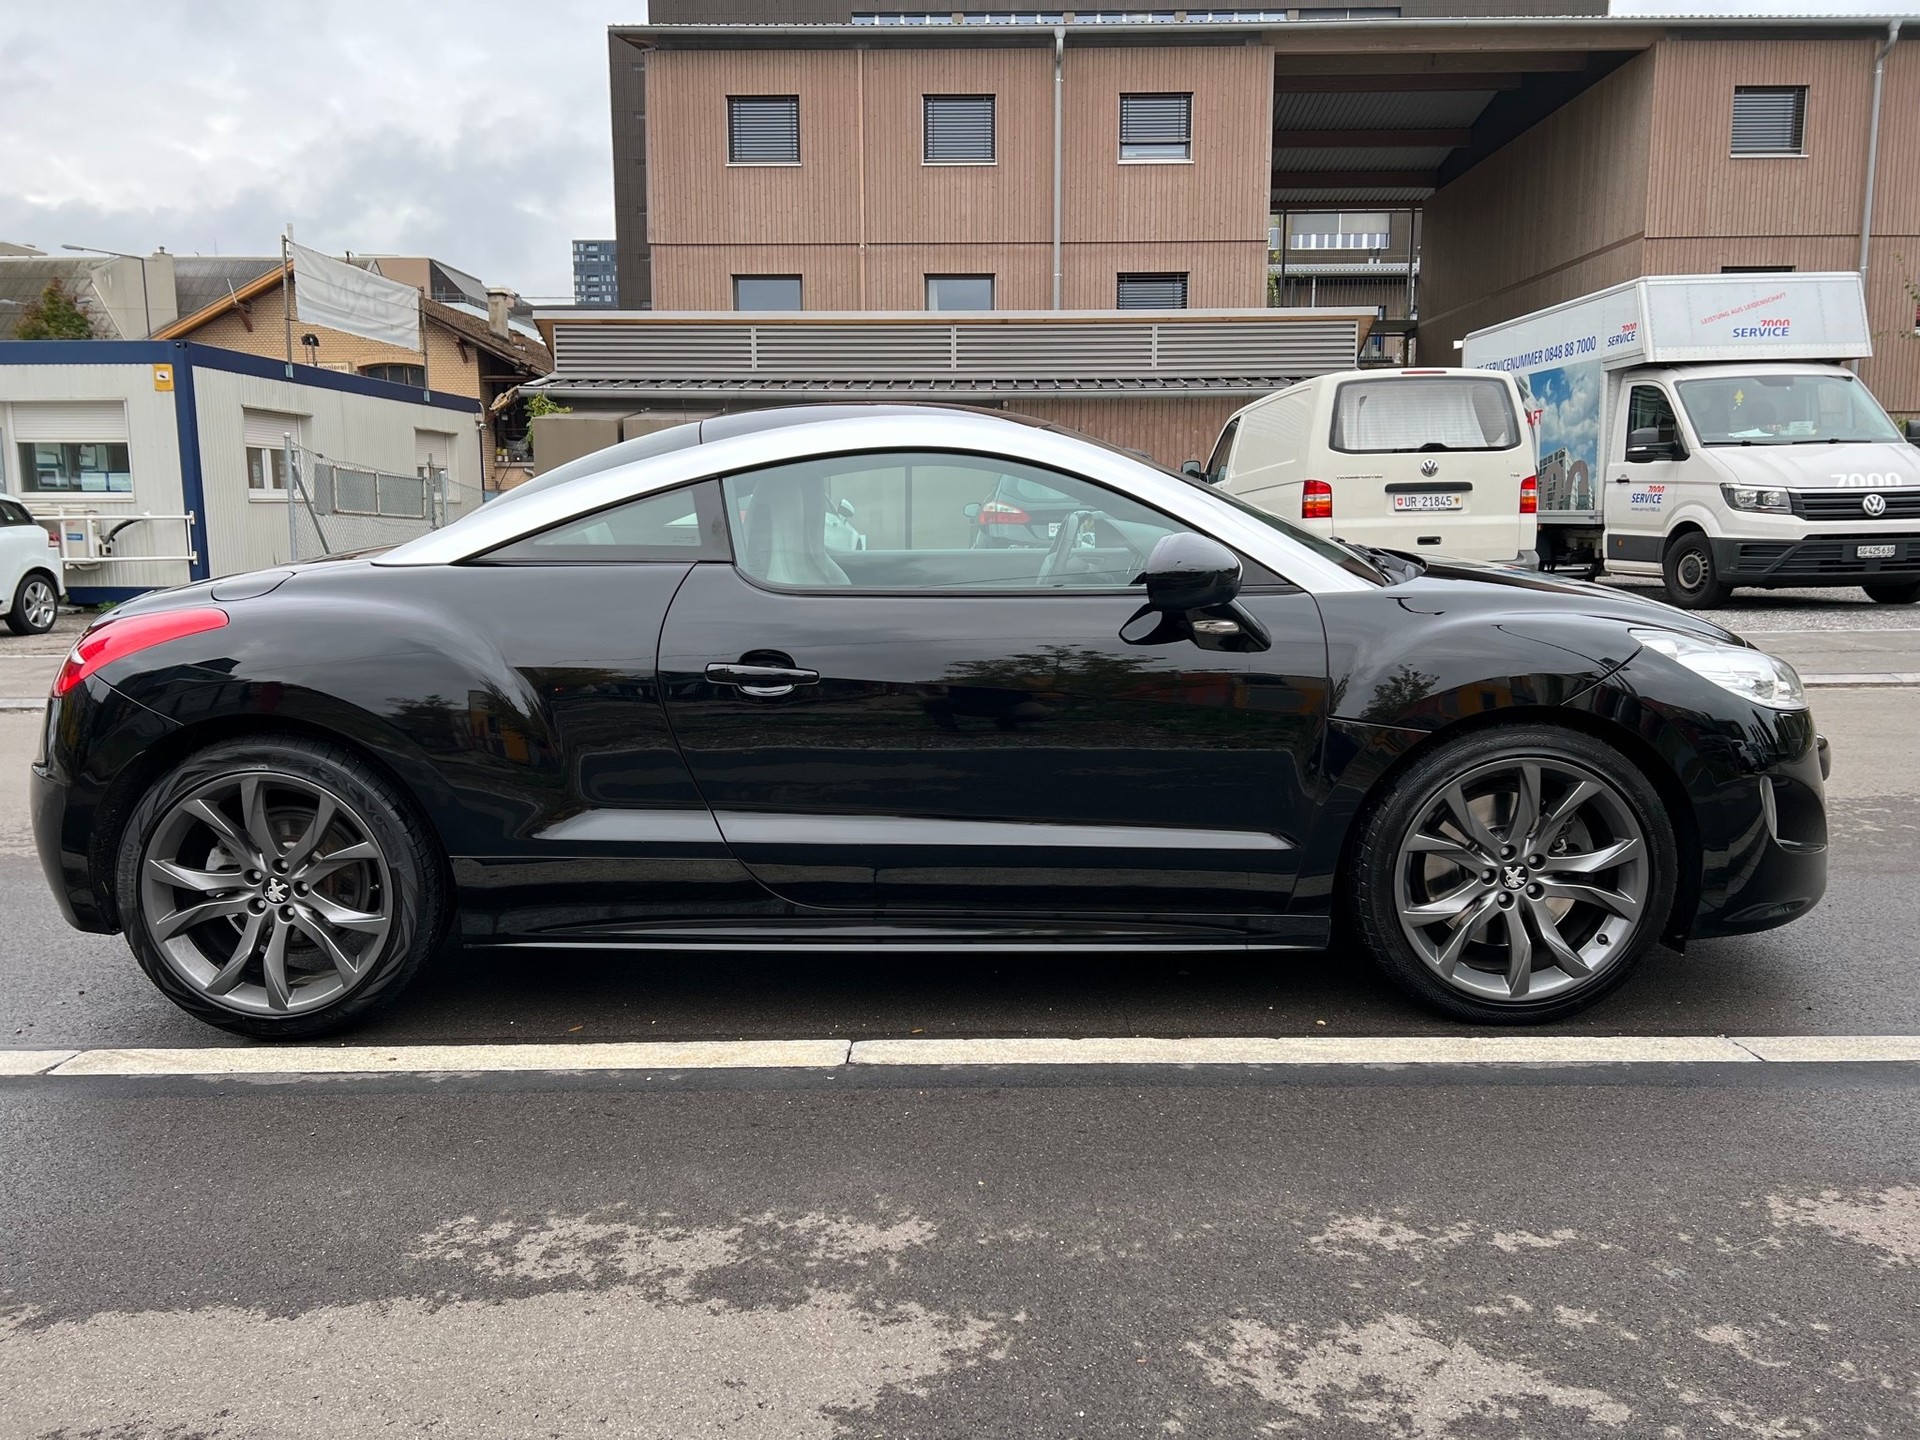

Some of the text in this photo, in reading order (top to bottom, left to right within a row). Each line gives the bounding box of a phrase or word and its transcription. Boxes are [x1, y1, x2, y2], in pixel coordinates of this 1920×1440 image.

[1701, 292, 1787, 325] LEISTUNG AUS LEIDENSCHAFT
[1607, 331, 1636, 347] SERVICE
[1732, 327, 1790, 338] SERVICE
[1544, 344, 1563, 362] 0848
[1564, 341, 1574, 357] 88
[1576, 336, 1597, 355] 7000
[1631, 493, 1663, 504] SERVICE
